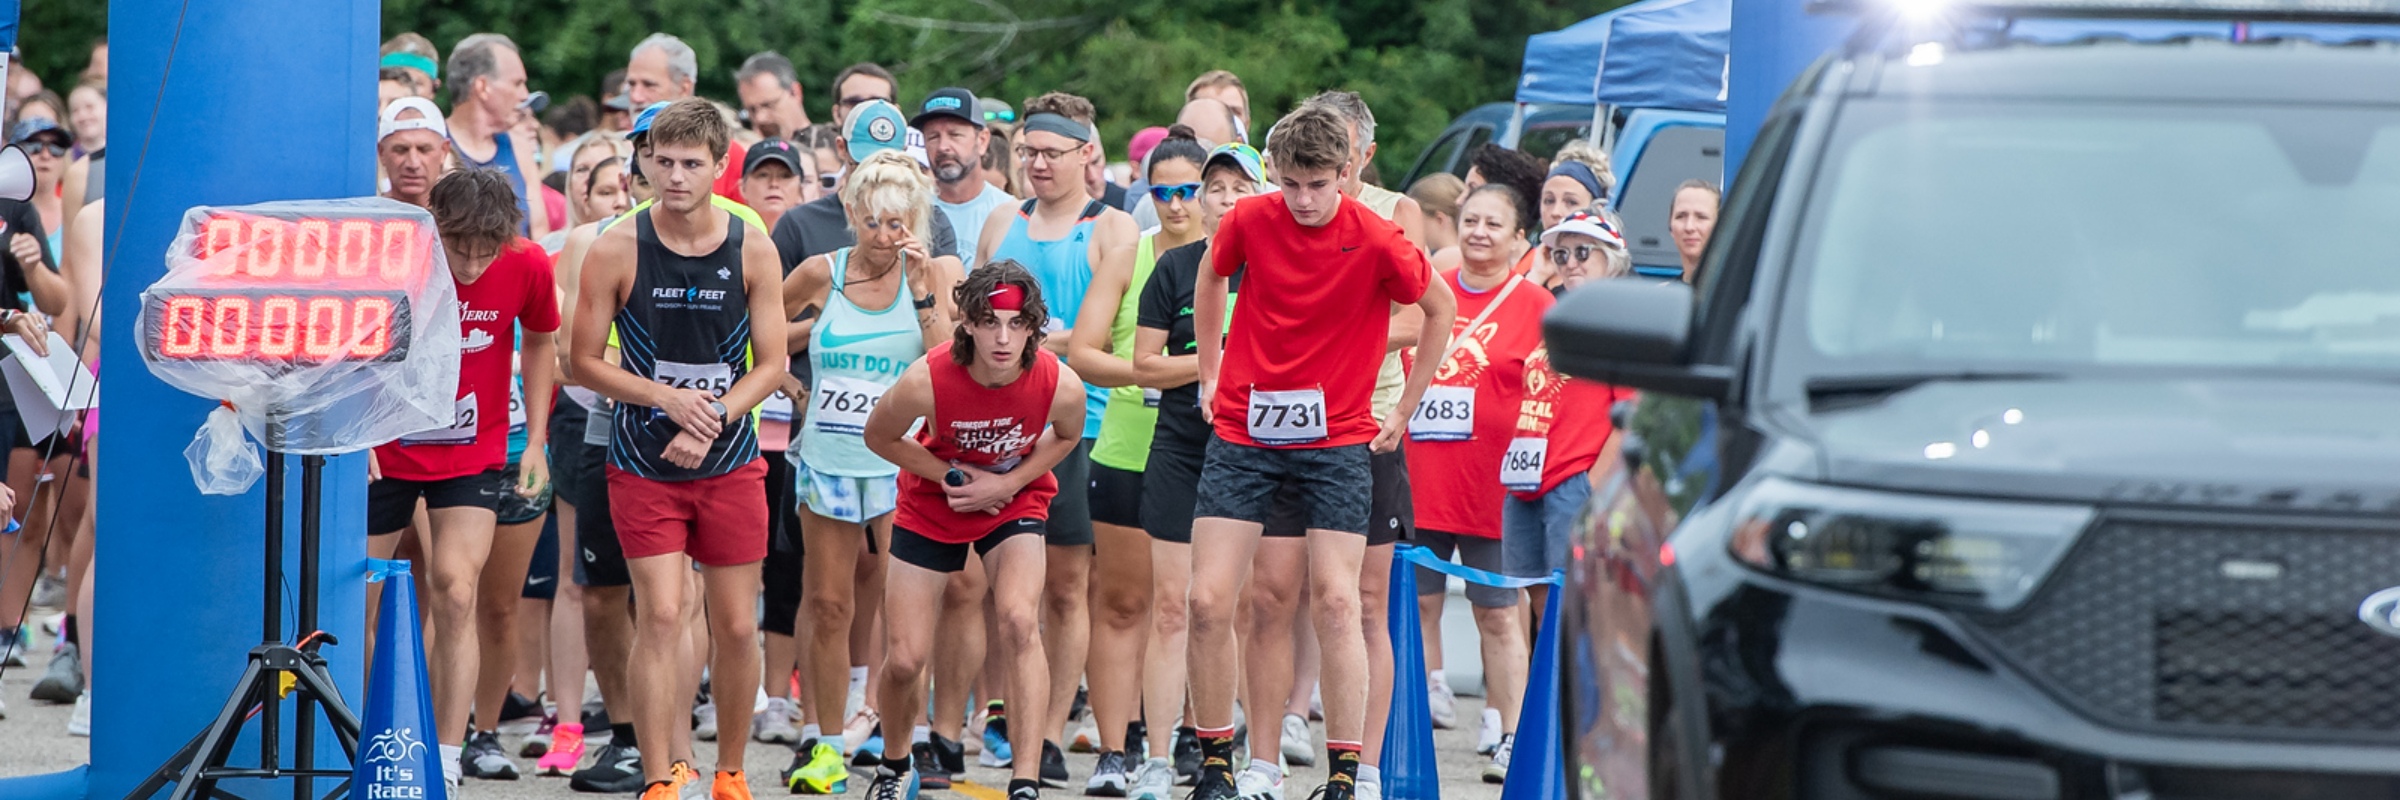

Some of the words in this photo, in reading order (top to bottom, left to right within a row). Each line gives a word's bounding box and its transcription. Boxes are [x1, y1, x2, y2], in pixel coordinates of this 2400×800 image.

[652, 287, 686, 298] FLEET
[698, 289, 727, 300] FEET
[165, 298, 388, 355] 00000
[865, 355, 890, 374] DO
[1253, 402, 1322, 428] 7731
[1412, 400, 1470, 420] 7683
[951, 420, 991, 430] CRIMSON
[993, 417, 1014, 427] TIDE
[955, 423, 1023, 441] CROSS
[376, 765, 414, 782] It's
[367, 783, 423, 800] Race
